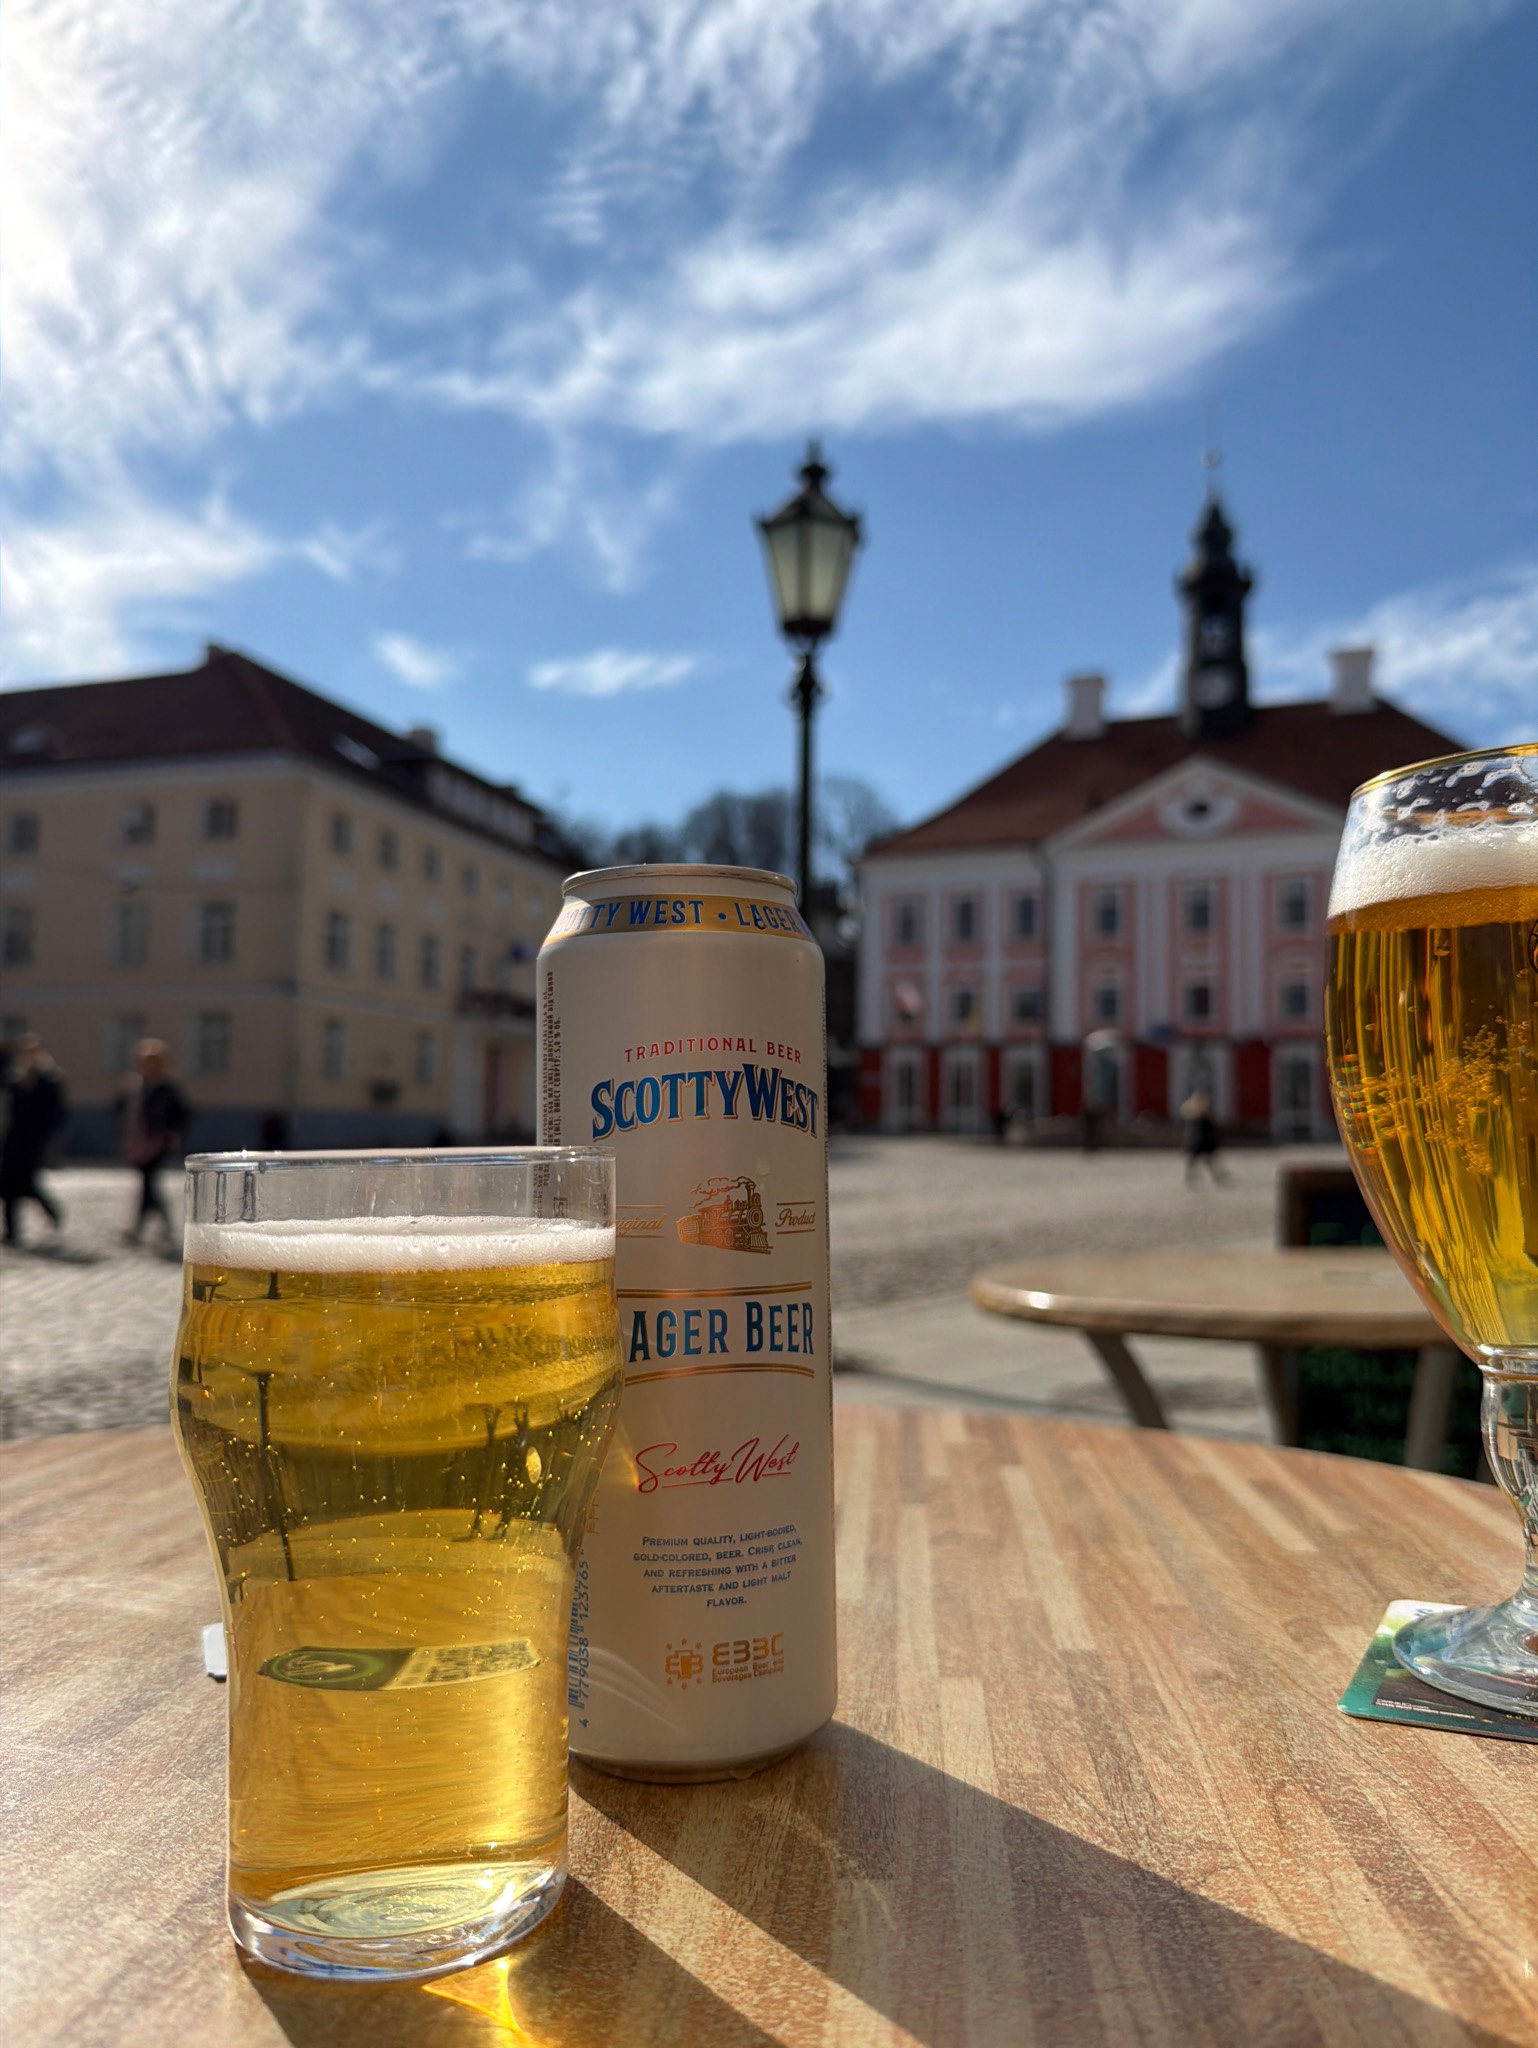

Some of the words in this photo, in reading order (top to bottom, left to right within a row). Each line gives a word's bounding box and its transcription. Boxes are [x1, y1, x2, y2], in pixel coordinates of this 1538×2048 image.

[549, 902, 622, 936] COTTY
[630, 900, 703, 925] WEST
[734, 902, 803, 933] LAGER
[625, 1037, 757, 1063] TRADITIONAL
[767, 1041, 801, 1064] BEER
[616, 1213, 667, 1237] riginal
[775, 1208, 816, 1228] Product
[629, 1309, 729, 1362] AGER
[745, 1301, 814, 1355] BEER
[635, 1442, 732, 1494] Scotty
[731, 1434, 800, 1484] West
[642, 1536, 689, 1546] PREMIUM
[693, 1535, 736, 1546] QUALITY,
[740, 1524, 797, 1542] LIGHT-BODIED,
[633, 1553, 712, 1562] GOLD-COLORED,
[716, 1550, 744, 1560] BEER.
[643, 1569, 664, 1578] AND
[669, 1567, 732, 1578] REFRESHING
[736, 1563, 758, 1574] WITH
[772, 1554, 797, 1568] BITTER
[578, 1560, 590, 1620] 123765
[652, 1583, 714, 1593] AFTERTASTE
[718, 1581, 739, 1591] AND
[743, 1577, 768, 1588] LIGHT
[772, 1571, 792, 1583] MALT
[706, 1596, 747, 1608] FLAVOR.
[579, 1637, 590, 1700] 779038
[579, 1719, 588, 1728] 4
